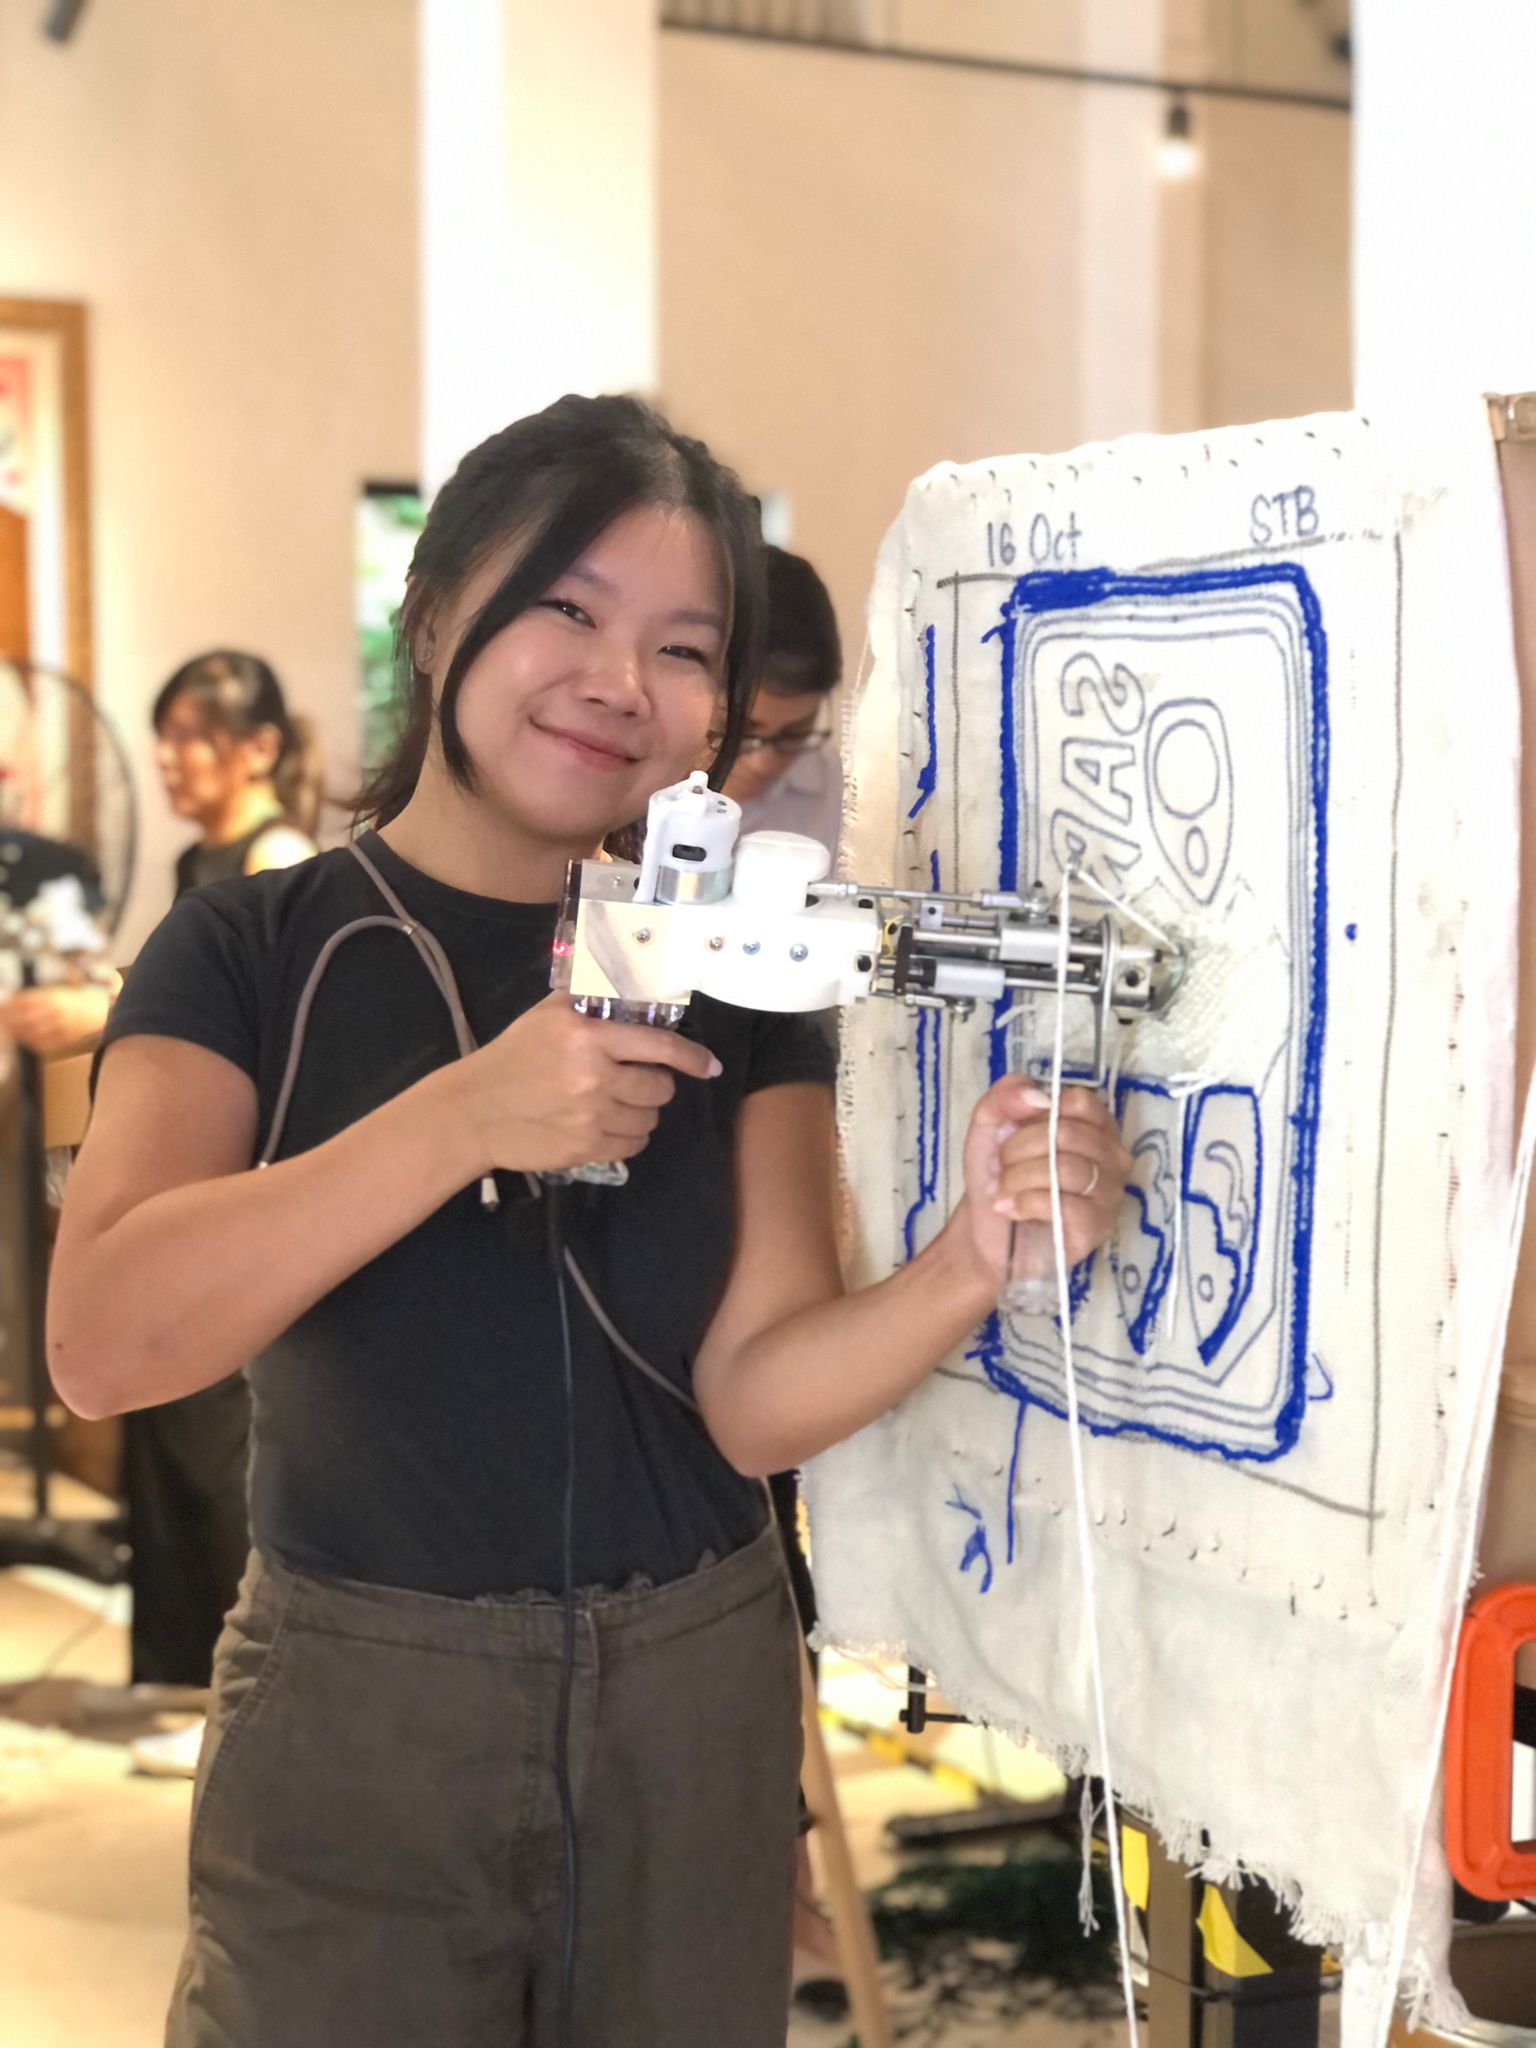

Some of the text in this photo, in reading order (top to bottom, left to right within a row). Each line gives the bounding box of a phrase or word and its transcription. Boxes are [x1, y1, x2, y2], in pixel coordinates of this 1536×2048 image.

[986, 511, 1082, 567] 16 Oct
[1249, 485, 1319, 546] STB
